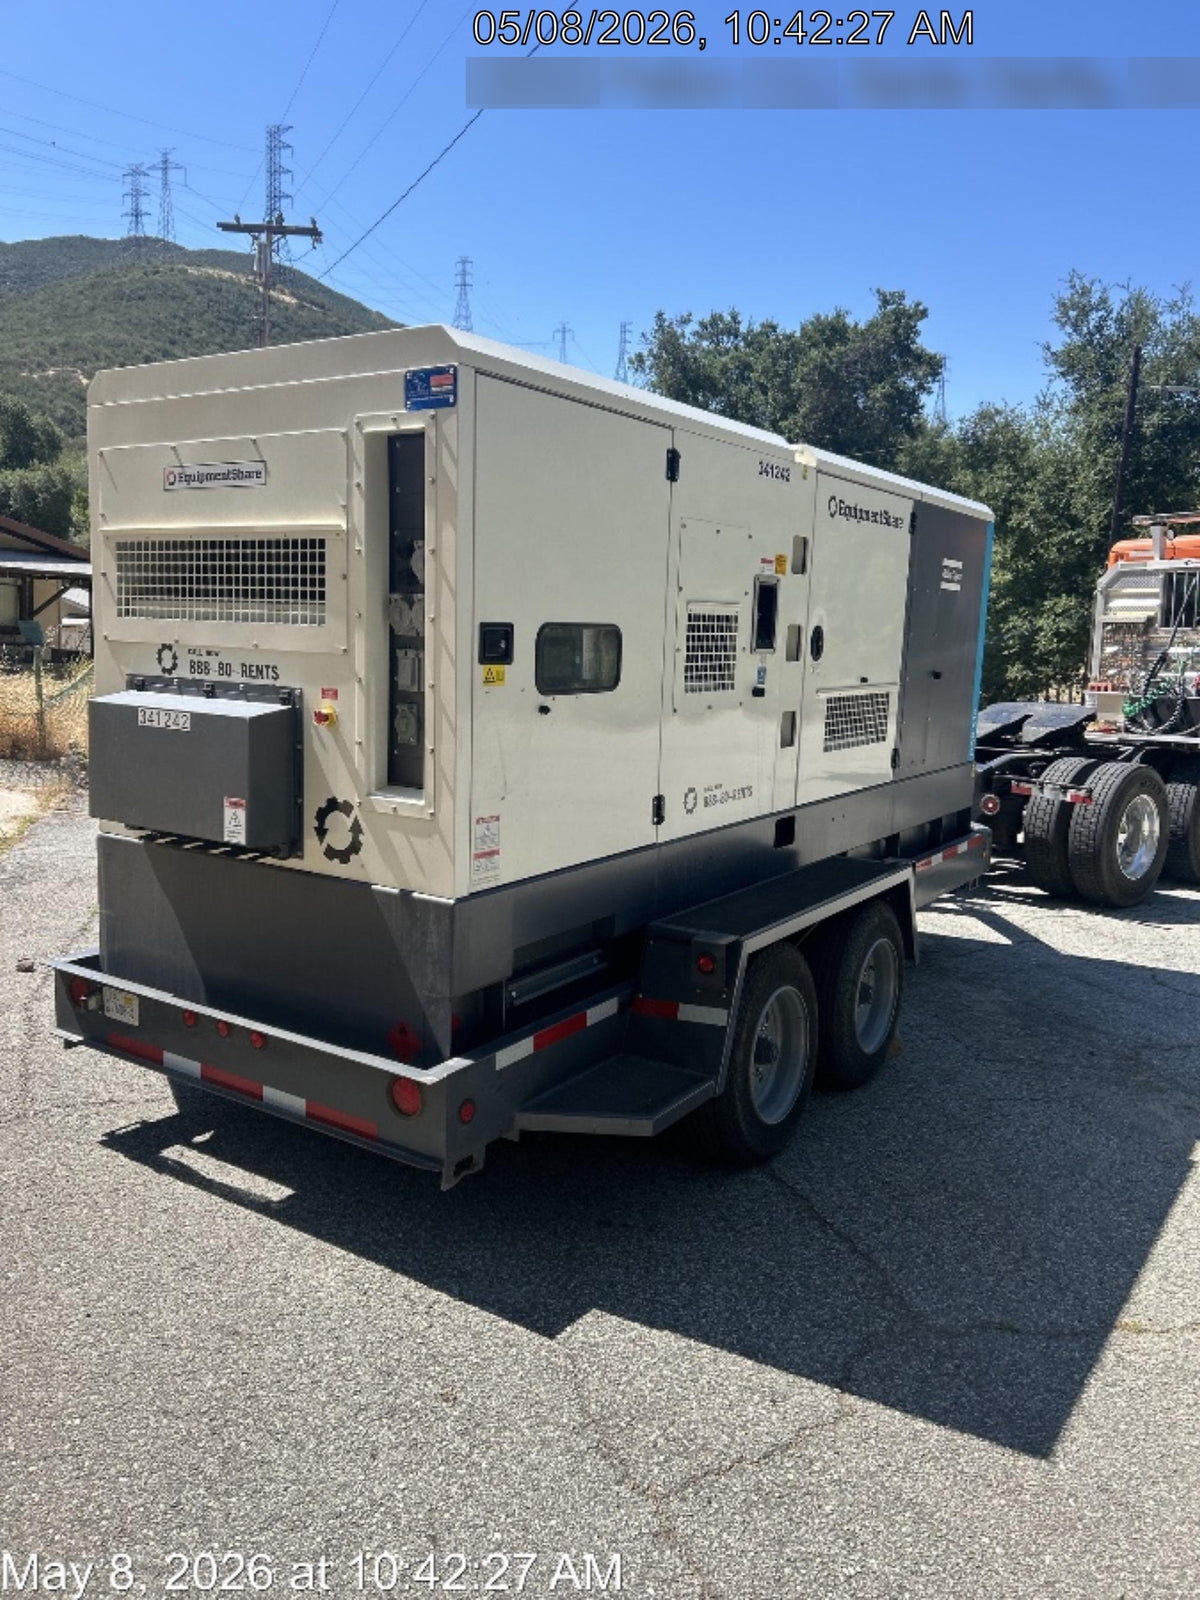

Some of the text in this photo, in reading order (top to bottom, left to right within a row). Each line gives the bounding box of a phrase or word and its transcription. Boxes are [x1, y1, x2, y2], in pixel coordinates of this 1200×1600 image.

[178, 468, 262, 485] EquipmentShare
[758, 460, 791, 482] 341242
[139, 709, 189, 729] 341242
